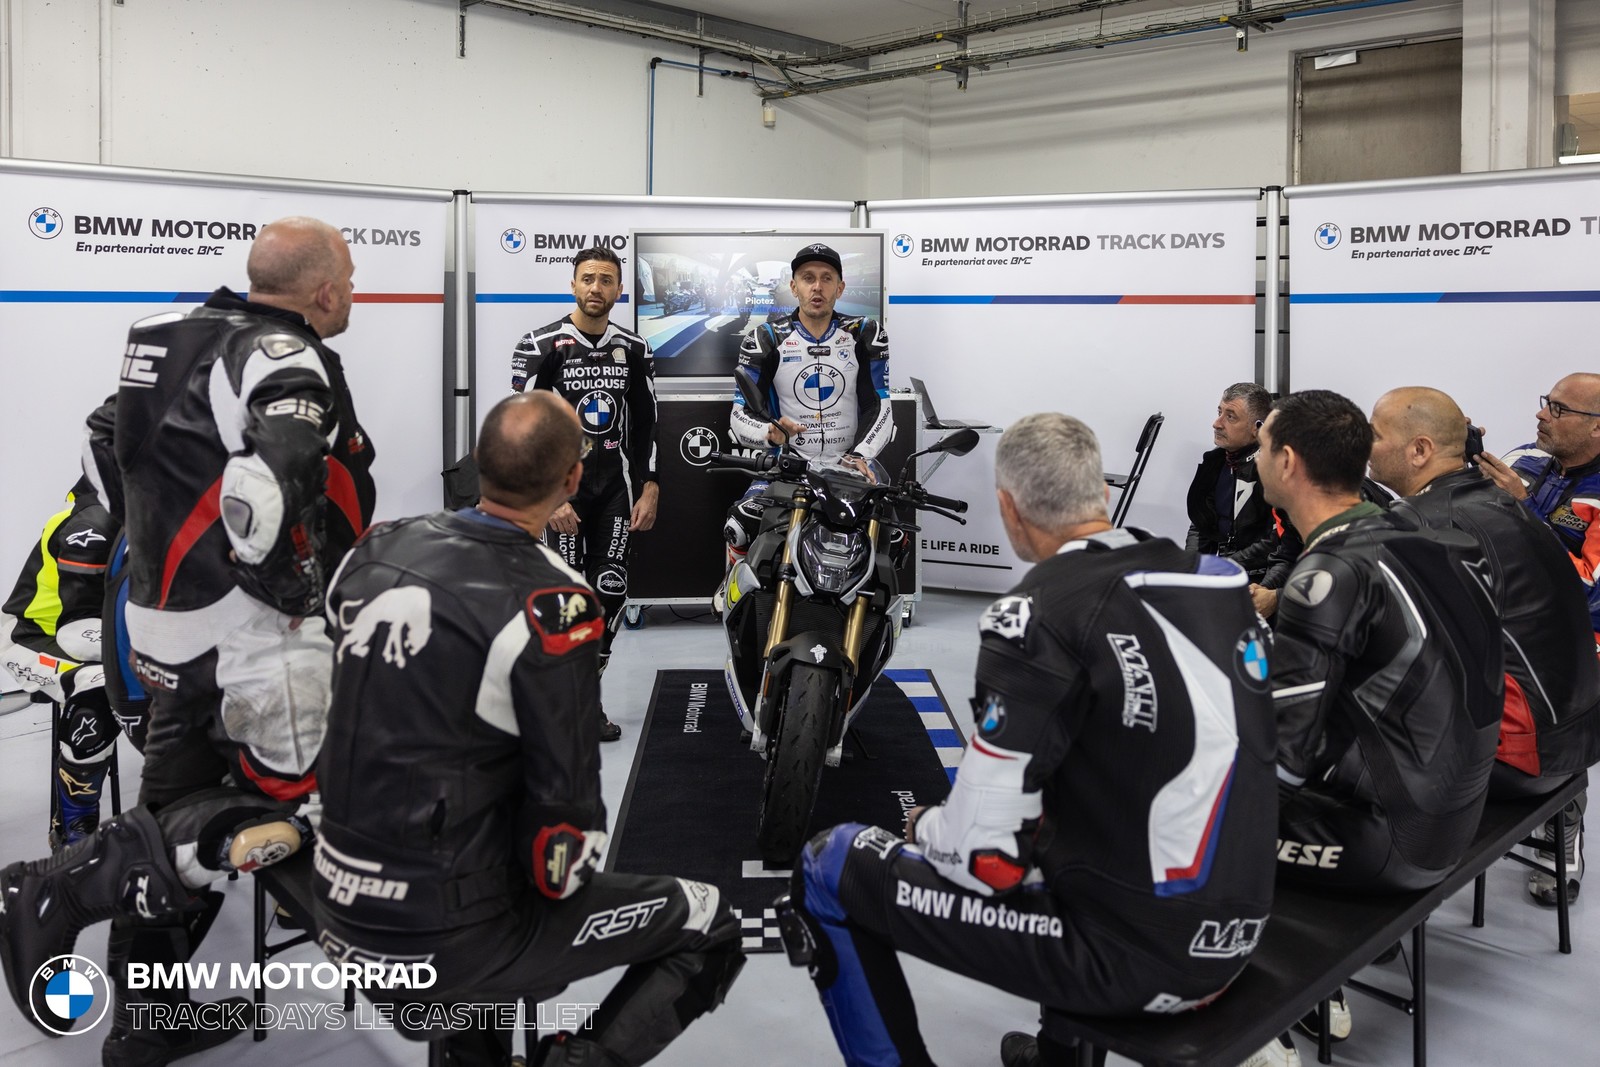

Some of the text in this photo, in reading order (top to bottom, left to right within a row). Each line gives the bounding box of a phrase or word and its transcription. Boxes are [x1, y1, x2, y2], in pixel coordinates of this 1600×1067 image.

[74, 215, 143, 237] BMW
[151, 218, 267, 241] MOTORR
[371, 228, 421, 247] DAYS
[1350, 224, 1411, 244] BMW
[1418, 217, 1571, 242] MOTORRAD
[75, 241, 92, 252] En
[94, 243, 165, 255] partenariat
[166, 246, 194, 255] avec
[534, 234, 629, 251] BMW MO
[921, 232, 1226, 253] BMW MOTORRAD TRACK DAYS
[535, 254, 547, 263] En
[1351, 249, 1365, 259] En
[1366, 246, 1431, 261] partenariat
[1432, 248, 1460, 257] avec
[921, 257, 933, 266] En
[934, 256, 986, 268] partenariat
[986, 258, 1008, 266] avec
[745, 296, 775, 305] Pilotez
[563, 365, 629, 378] MOTO RIDE
[800, 366, 839, 380] BMW
[563, 378, 626, 391] TOULOUSE
[582, 392, 613, 406] BMW
[686, 429, 714, 440] BMW
[612, 516, 623, 538] RIDE
[931, 540, 956, 552] LIFE
[959, 543, 967, 553] A
[970, 543, 1000, 555] RIDE
[683, 683, 708, 733] BMW Motorrad
[1277, 838, 1344, 869] ESE
[896, 879, 956, 920] BMW
[572, 896, 668, 947] RST
